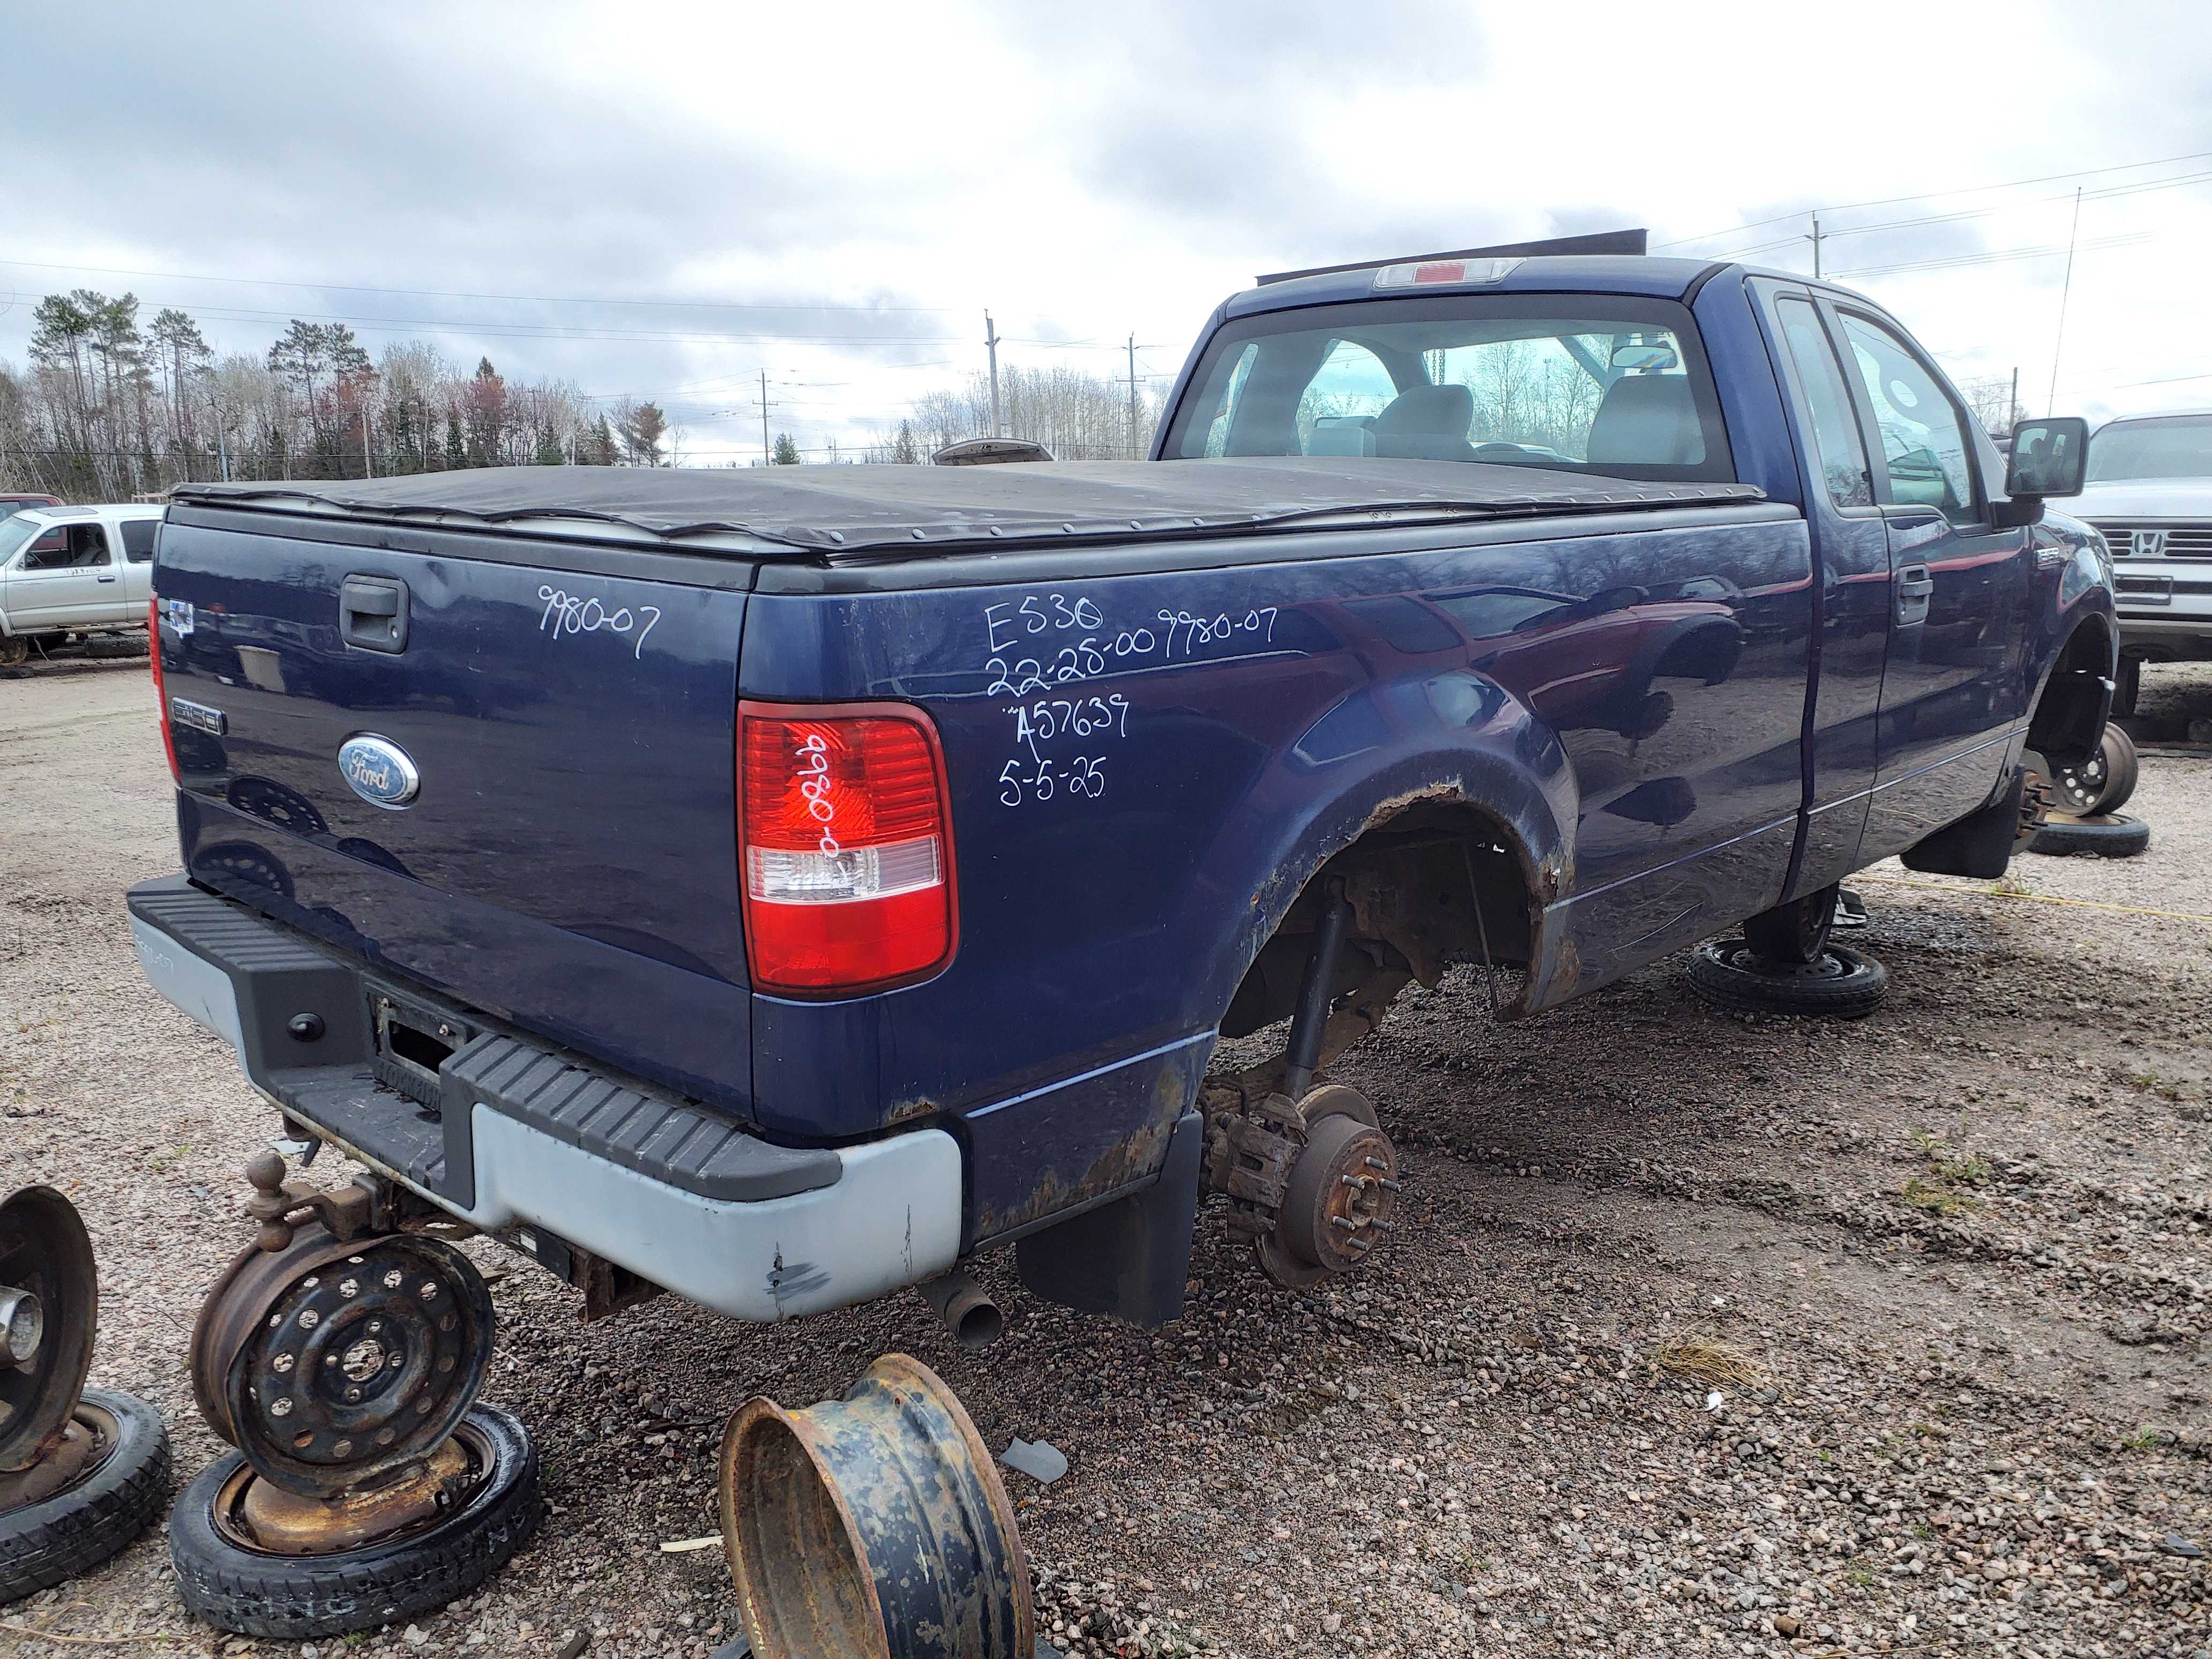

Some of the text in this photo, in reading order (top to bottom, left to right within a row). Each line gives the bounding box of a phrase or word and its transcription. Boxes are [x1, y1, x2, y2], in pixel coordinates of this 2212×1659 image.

[538, 585, 661, 660] 9980-07
[349, 749, 390, 791] Ford
[998, 756, 1107, 807] 5-5-25
